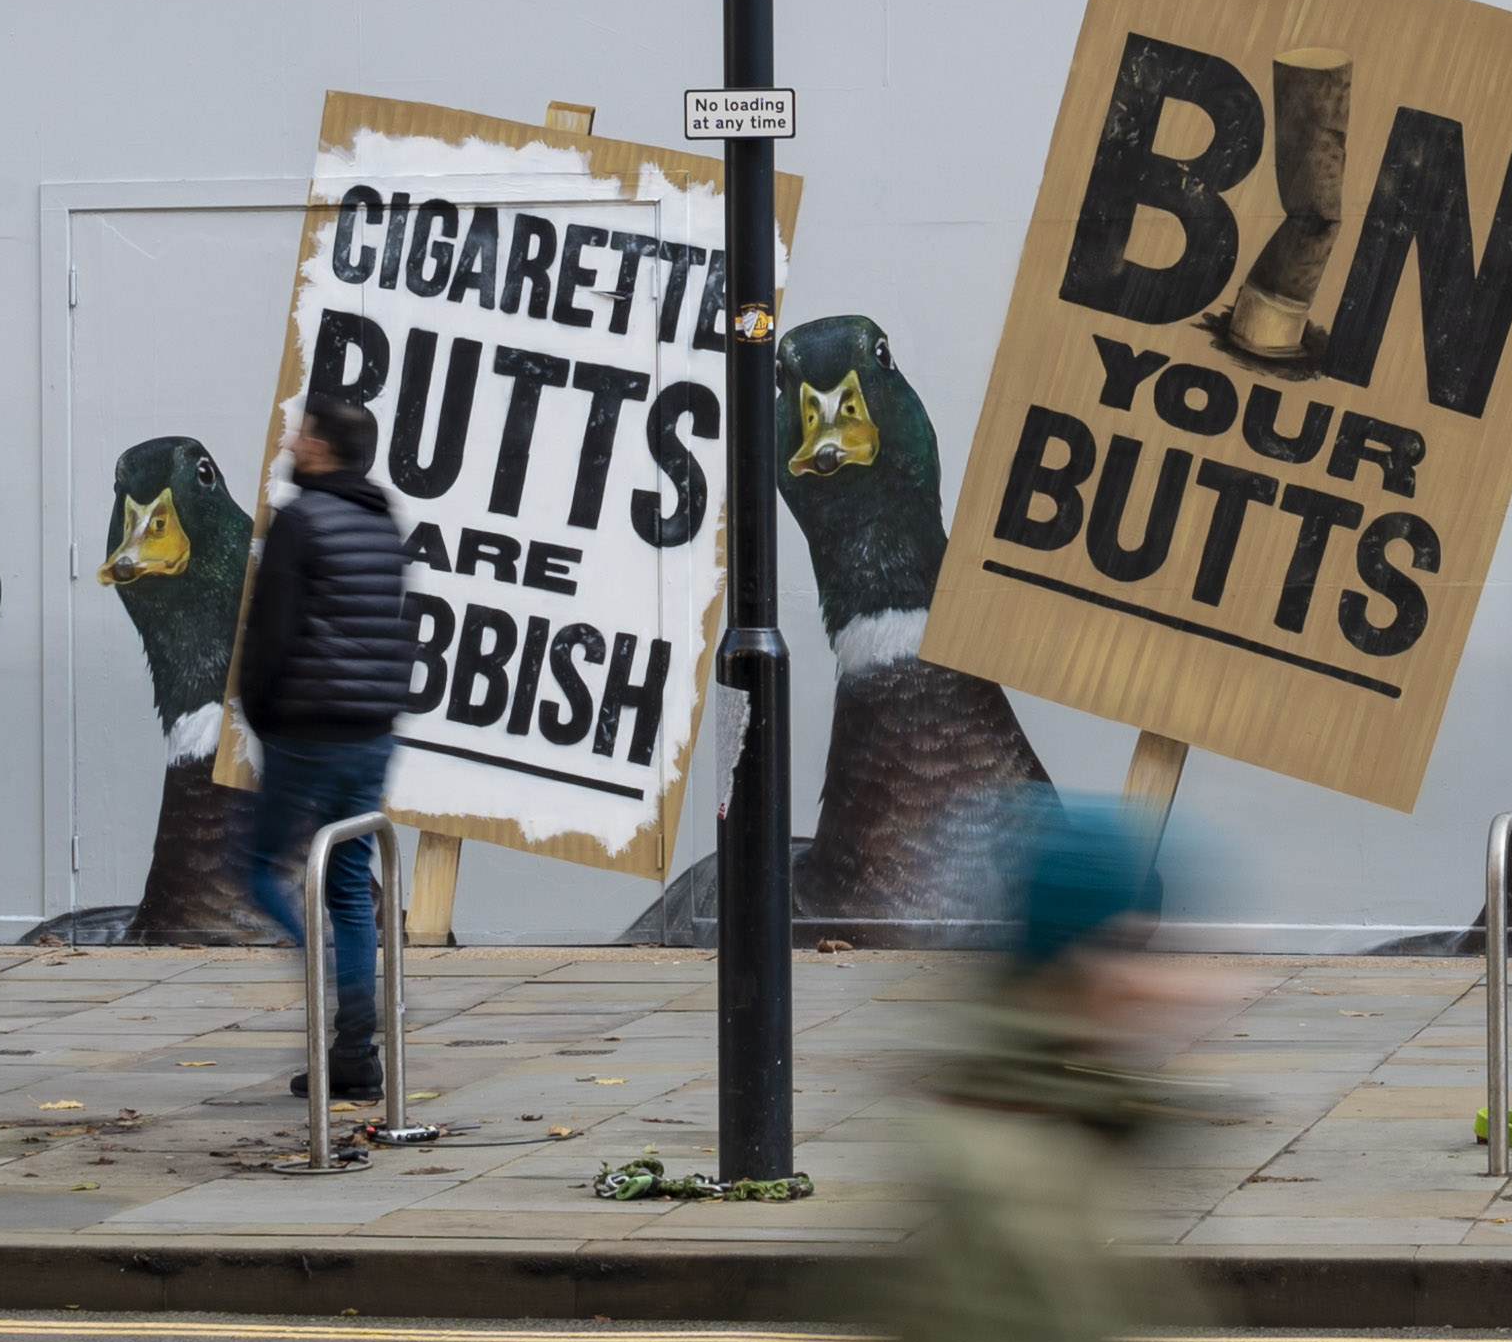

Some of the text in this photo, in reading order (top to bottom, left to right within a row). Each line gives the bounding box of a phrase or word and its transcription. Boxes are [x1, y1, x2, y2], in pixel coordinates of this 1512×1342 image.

[693, 116, 786, 132] at any time
[695, 98, 785, 113] No loading
[302, 309, 720, 548] BUTTS
[1092, 335, 1428, 499] YOUR
[402, 522, 583, 596] ARE
[993, 405, 1442, 657] BUTTS
